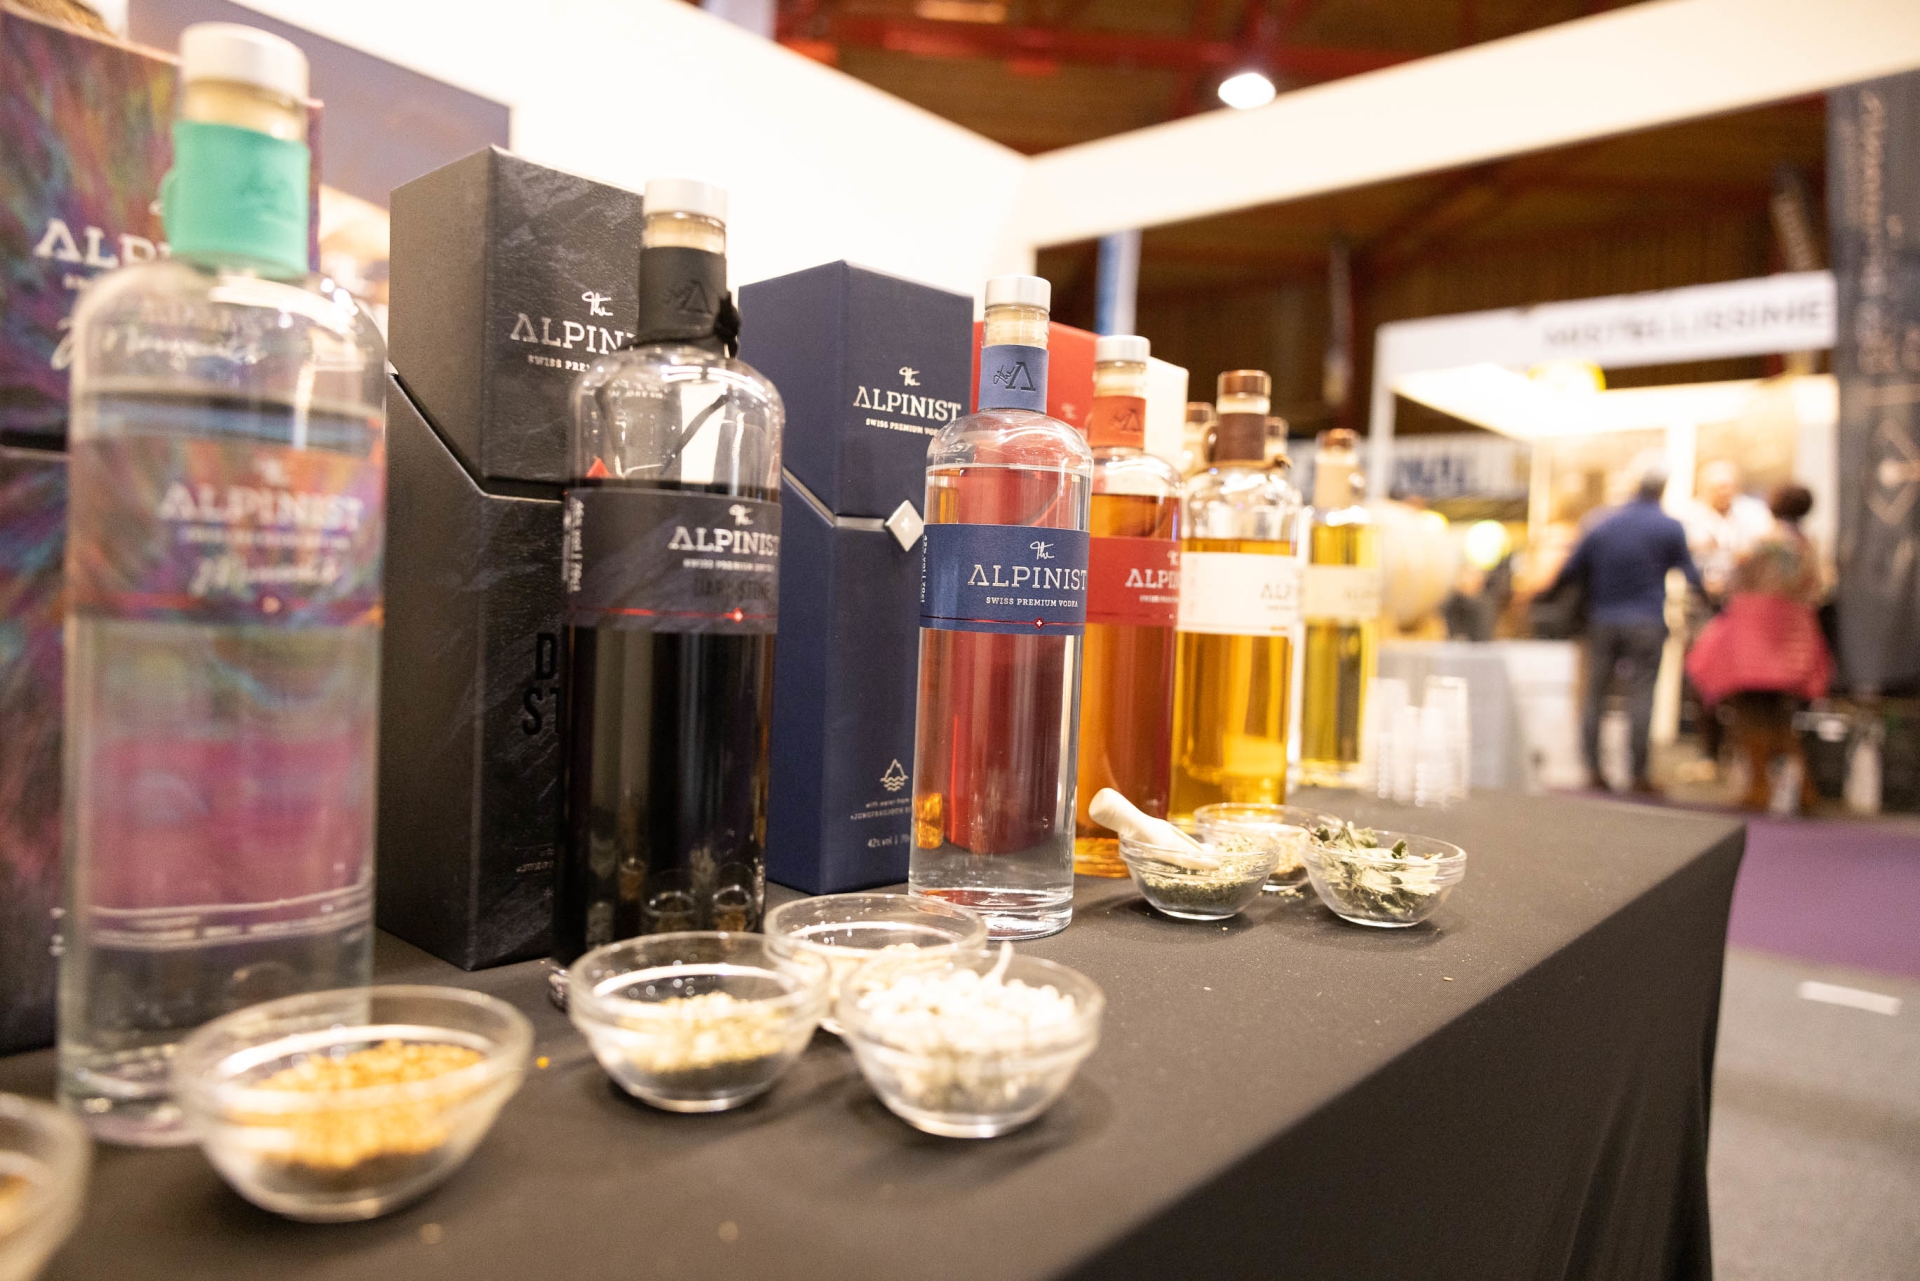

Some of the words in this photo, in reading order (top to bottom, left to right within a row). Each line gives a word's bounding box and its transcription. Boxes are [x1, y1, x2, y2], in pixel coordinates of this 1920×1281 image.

[853, 385, 962, 422] ALPINIST
[865, 418, 889, 429] SWISS
[889, 421, 924, 434] PREMIUM
[1029, 541, 1055, 560] The
[967, 564, 1088, 591] ALPINIST
[985, 596, 1014, 606] SWISS
[1016, 598, 1057, 608] PREMIUM
[1058, 599, 1079, 608] VODKA
